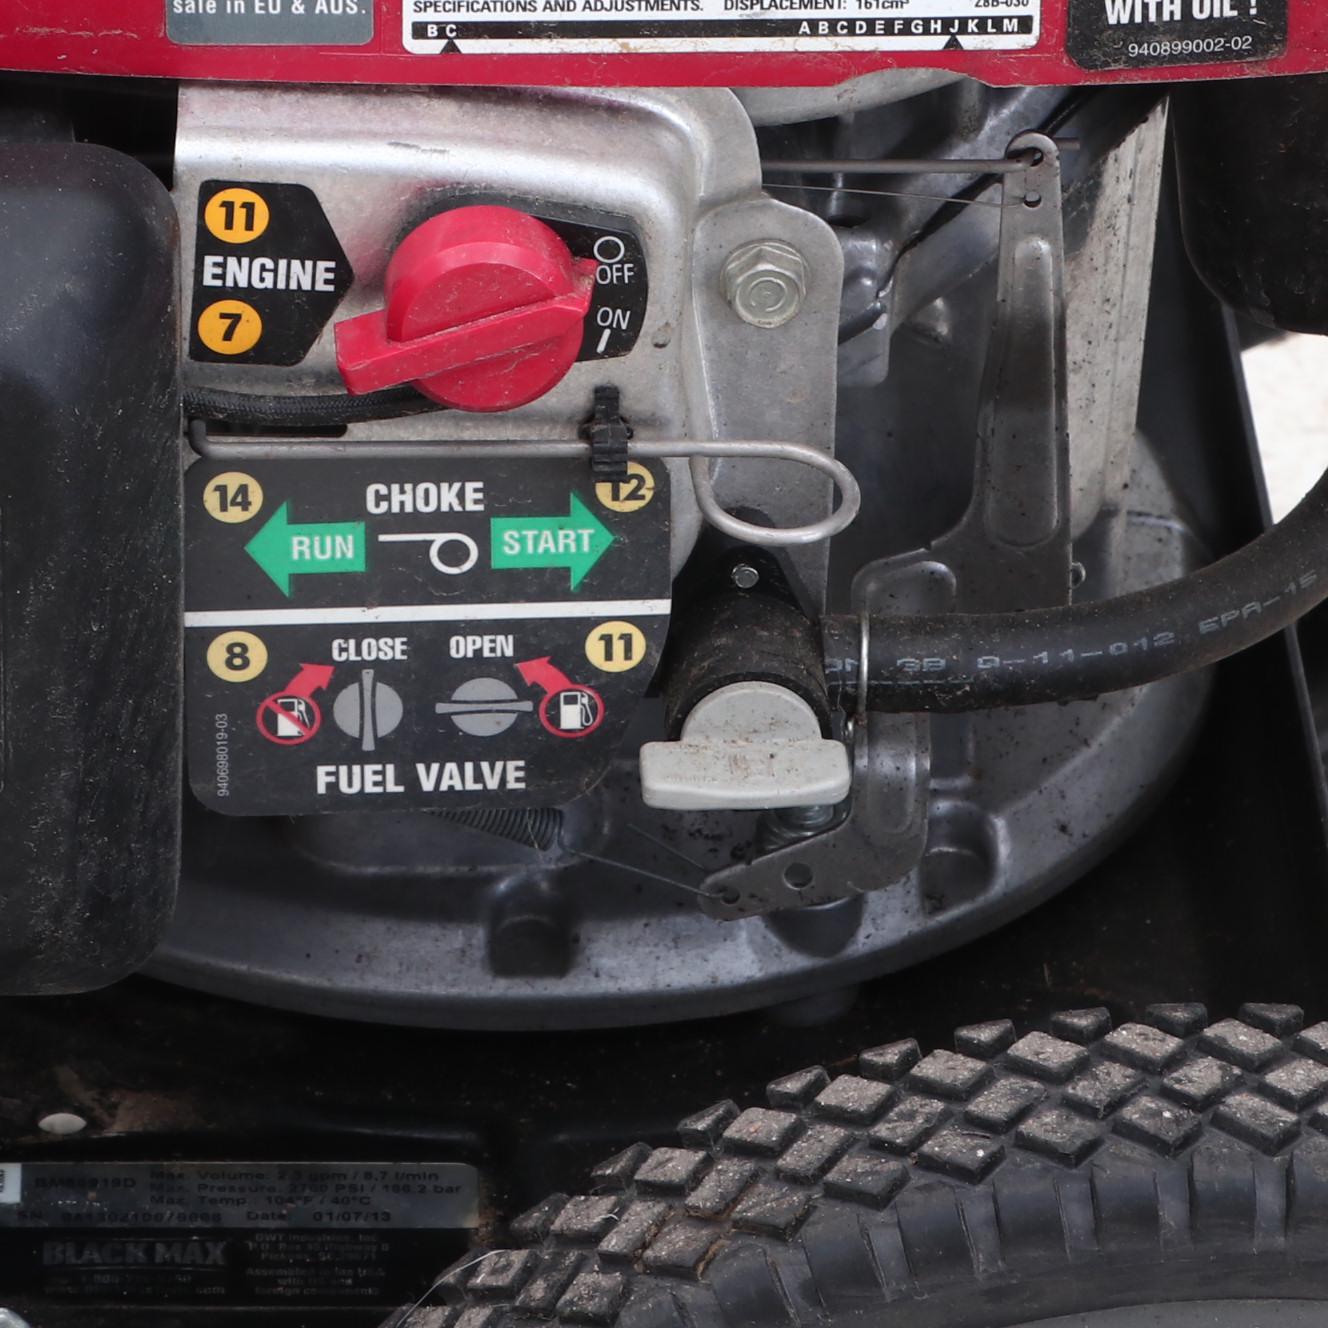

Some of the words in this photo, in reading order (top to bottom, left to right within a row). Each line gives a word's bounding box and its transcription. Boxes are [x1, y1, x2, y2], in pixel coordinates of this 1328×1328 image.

[414, 0, 537, 13] SPECIFICATIONS
[543, 0, 576, 12] AND
[582, 0, 703, 11] ADJUSTMENTS.
[1129, 36, 1252, 57] 940899002-02
[220, 201, 255, 231] 11
[203, 256, 335, 291] ENGINE
[596, 264, 633, 284] OFF
[219, 313, 242, 341] 7
[597, 307, 630, 329] ON
[213, 484, 251, 512] 14
[367, 482, 484, 514] CHOKE
[611, 473, 646, 501] 12
[292, 535, 353, 561] RUN
[504, 530, 594, 554] START
[225, 642, 250, 670] 8
[332, 638, 407, 661] CLOSE
[450, 635, 513, 658] OPEN
[599, 633, 632, 661] 11
[317, 764, 404, 794] FUEL
[416, 761, 525, 791] VALVE
[313, 1212, 391, 1221] 01/07/13
[43, 1241, 147, 1265] BLACK
[154, 1240, 226, 1265] MAX
